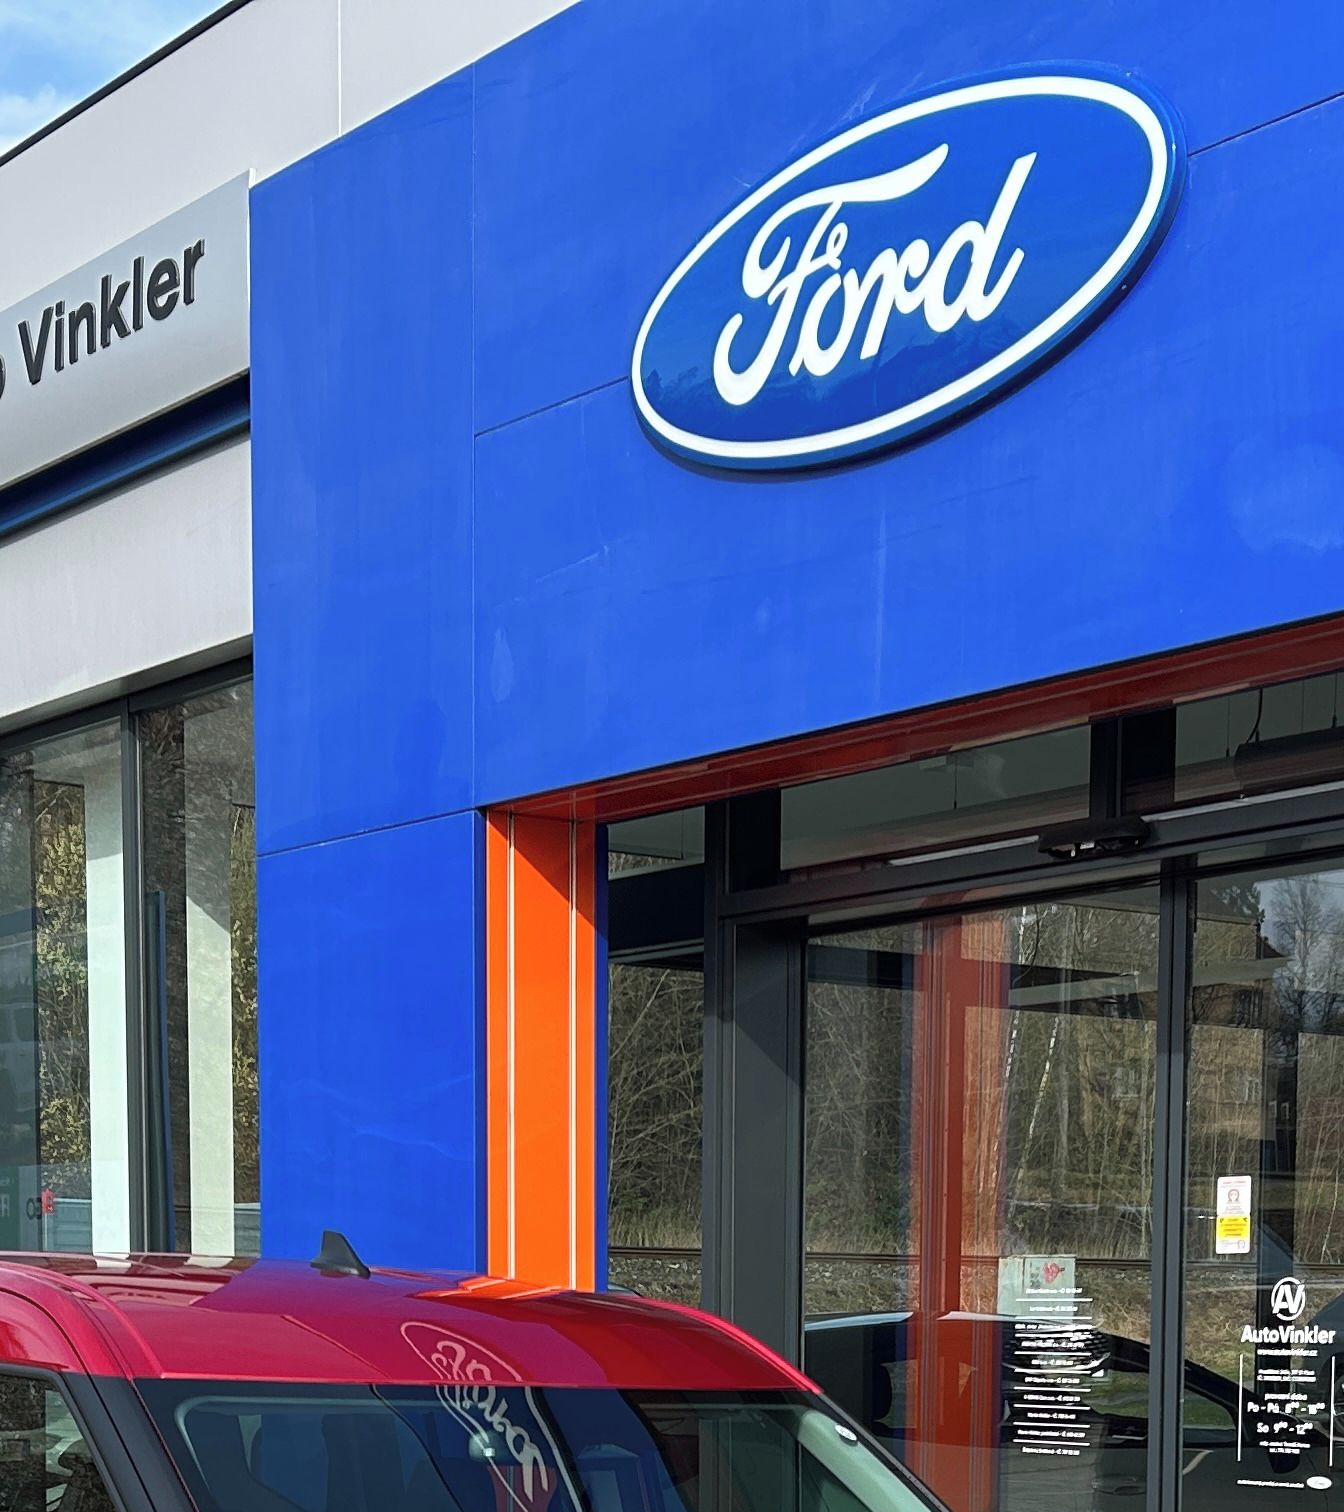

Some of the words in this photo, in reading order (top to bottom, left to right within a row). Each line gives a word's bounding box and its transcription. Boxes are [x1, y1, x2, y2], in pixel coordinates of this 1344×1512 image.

[17, 238, 206, 386] Vinkler
[713, 143, 1038, 406] Ford
[1240, 1325, 1336, 1345] AutoVinkler
